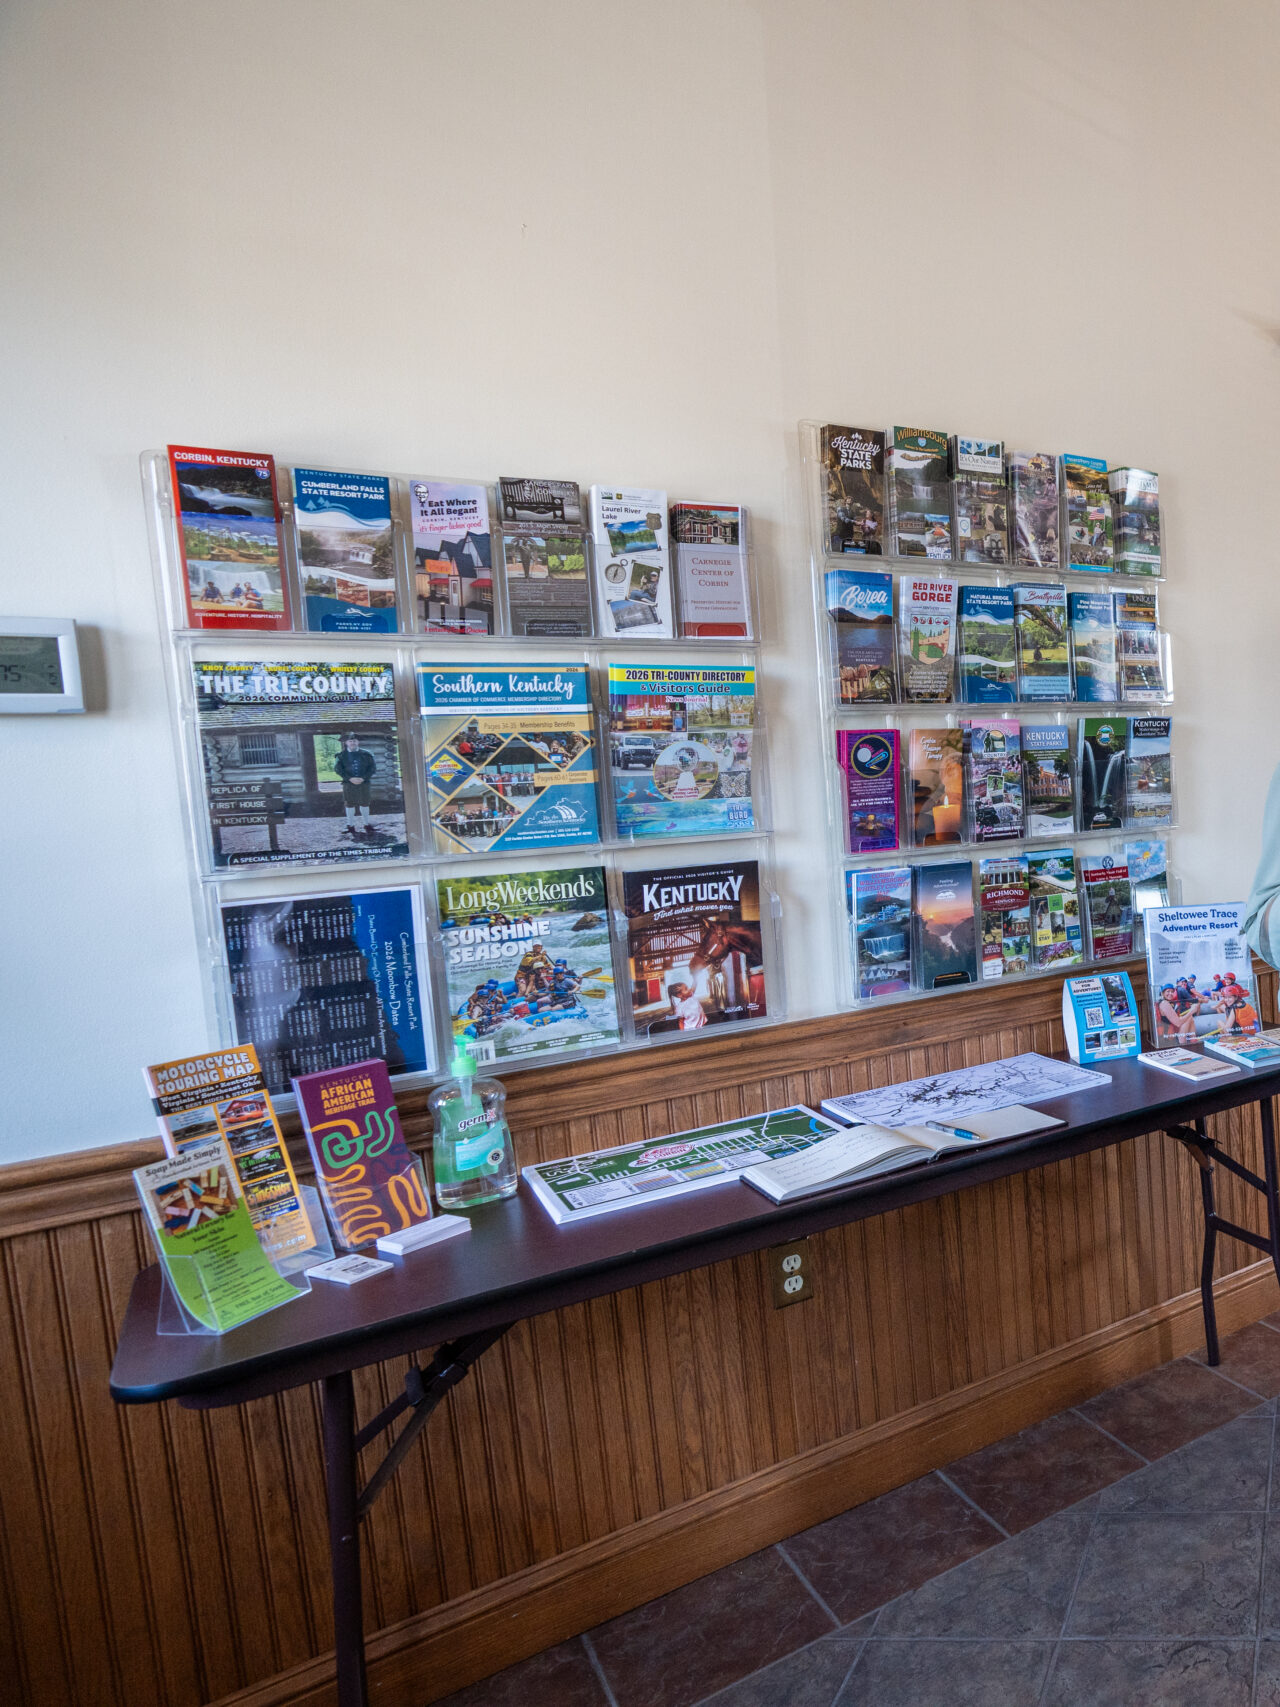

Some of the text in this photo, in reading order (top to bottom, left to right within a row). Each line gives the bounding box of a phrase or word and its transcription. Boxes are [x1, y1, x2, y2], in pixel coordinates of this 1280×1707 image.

[831, 435, 881, 457] Kentucky
[896, 427, 947, 452] Williamsburg
[174, 451, 270, 469] CORBIN, KENTUCKY
[840, 448, 872, 462] STATE
[840, 457, 872, 471] PARKS
[258, 470, 269, 479] 75
[340, 473, 360, 481] STATE
[302, 480, 386, 494] CUMBERLAND FALLS
[302, 487, 386, 501] STATE RESORT PARK
[428, 498, 478, 508] Eat Where
[602, 505, 641, 515] Laurel River
[421, 506, 478, 518] It All Began!
[602, 513, 618, 521] Lake
[692, 557, 732, 567] CARNEGIE
[691, 567, 722, 577] CENTER
[698, 578, 730, 588] CORBIN
[912, 582, 953, 592] RED RIVER
[840, 585, 888, 609] Berea
[911, 591, 953, 603] GORGE
[970, 593, 992, 601] NATURAL
[981, 598, 1000, 606] RESORT
[1023, 590, 1064, 604] Beattyville
[203, 665, 225, 673] KNOX
[225, 665, 254, 673] COUNTY
[264, 665, 291, 673] LAUREL
[331, 666, 358, 674] WHITLEY
[626, 670, 746, 682] 2026 TRI-COUNTY DIRECTORY
[200, 675, 390, 695] THE TRI-COUNTY
[432, 674, 576, 701] Southern Kentucky
[649, 682, 694, 693] Visitors
[697, 683, 731, 693] Guide
[239, 695, 266, 703] 2026
[268, 695, 330, 703] COMMUNITY
[684, 696, 708, 704] Journal
[484, 720, 576, 731] Pages Membership Benefits
[1134, 719, 1169, 728] KENTUCKY
[1026, 731, 1065, 742] KENTUCKY
[211, 785, 263, 794] REPLICA OF
[210, 800, 268, 811] FIRST HOUSE
[213, 816, 268, 825] IN KENTUCKY
[240, 856, 270, 864] SPECIAL
[270, 853, 317, 862] SUPPLEMENT
[343, 848, 393, 857] TIMES-TRIBUNE
[642, 875, 745, 914] KENTUCKY
[986, 889, 1025, 900] RICHMOND
[994, 897, 1016, 905] KENTUCKY
[653, 908, 674, 921] Find
[673, 905, 694, 917] what
[718, 904, 734, 914] you
[1158, 908, 1239, 924] Sheltowee Trace
[447, 920, 551, 947] SUNSHINE
[1162, 921, 1239, 933] Adventure Resort
[448, 940, 534, 966] SEASON
[384, 941, 400, 1026] 2026 Moonbow Dates
[399, 932, 419, 1031] Cumberland Falls State Resort Park
[156, 1052, 250, 1083] MOTORCYCLE
[156, 1062, 255, 1095] TOURING MAP
[320, 1073, 370, 1089] KENTUCKY
[160, 1074, 259, 1104] West Virginia Kentucky
[161, 1079, 262, 1109] Virginia Southeast Ohio
[321, 1078, 373, 1101] AFRICAN
[170, 1088, 254, 1113] THE BEST RIDES STOPS
[323, 1088, 375, 1110] AMERICAN
[325, 1097, 377, 1117] HERITAGE TRAIL
[145, 1163, 169, 1177] Soap
[168, 1156, 192, 1169] Made
[193, 1145, 222, 1162] Simply
[208, 1226, 225, 1236] Skin
